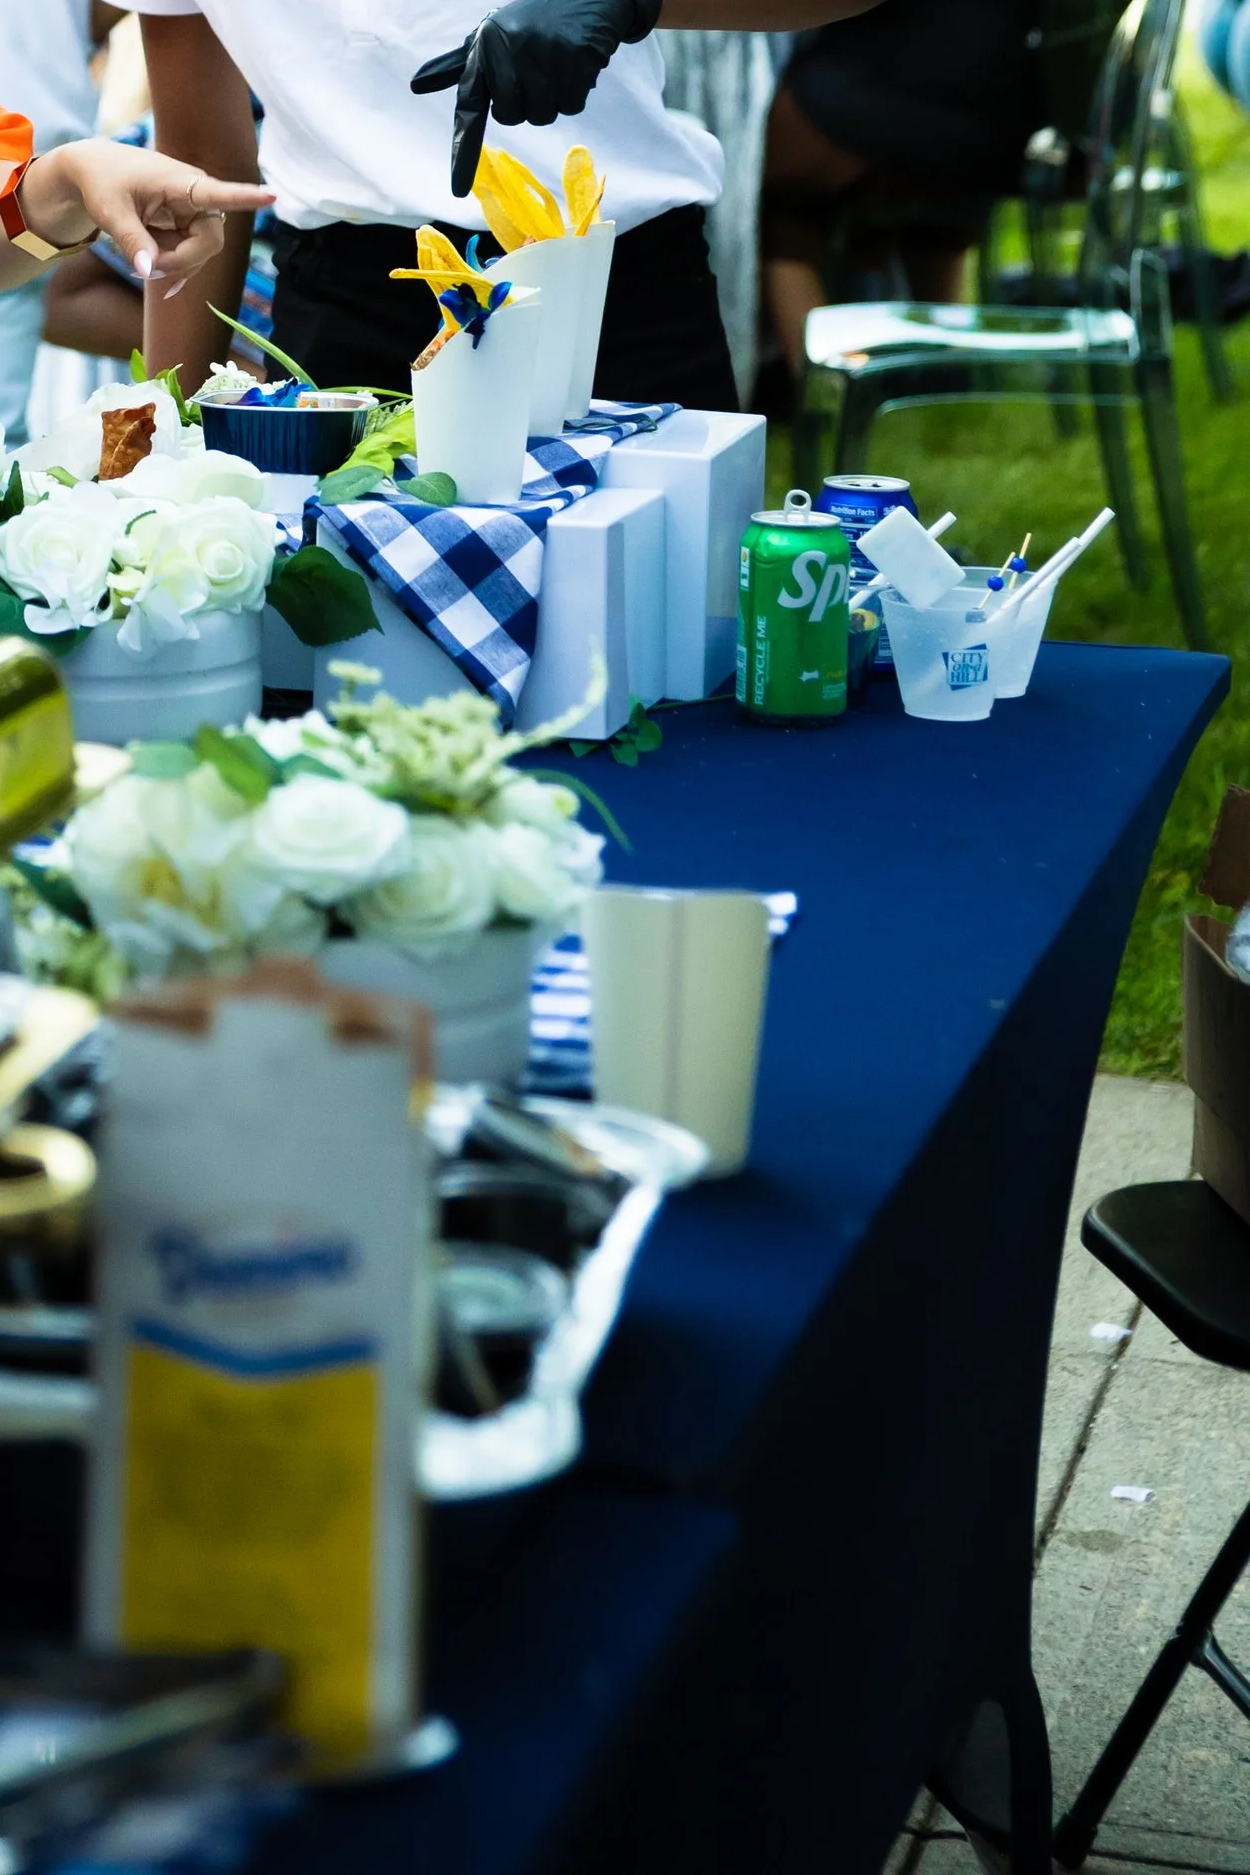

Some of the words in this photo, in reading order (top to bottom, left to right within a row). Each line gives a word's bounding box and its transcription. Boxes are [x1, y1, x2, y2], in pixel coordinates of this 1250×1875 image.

[830, 505, 856, 516] Nutrition
[857, 507, 875, 517] Facts
[777, 550, 849, 622] Sp
[756, 616, 767, 638] ME
[950, 652, 984, 663] CITY
[754, 640, 766, 706] RECYCLE
[950, 671, 982, 683] HILL
